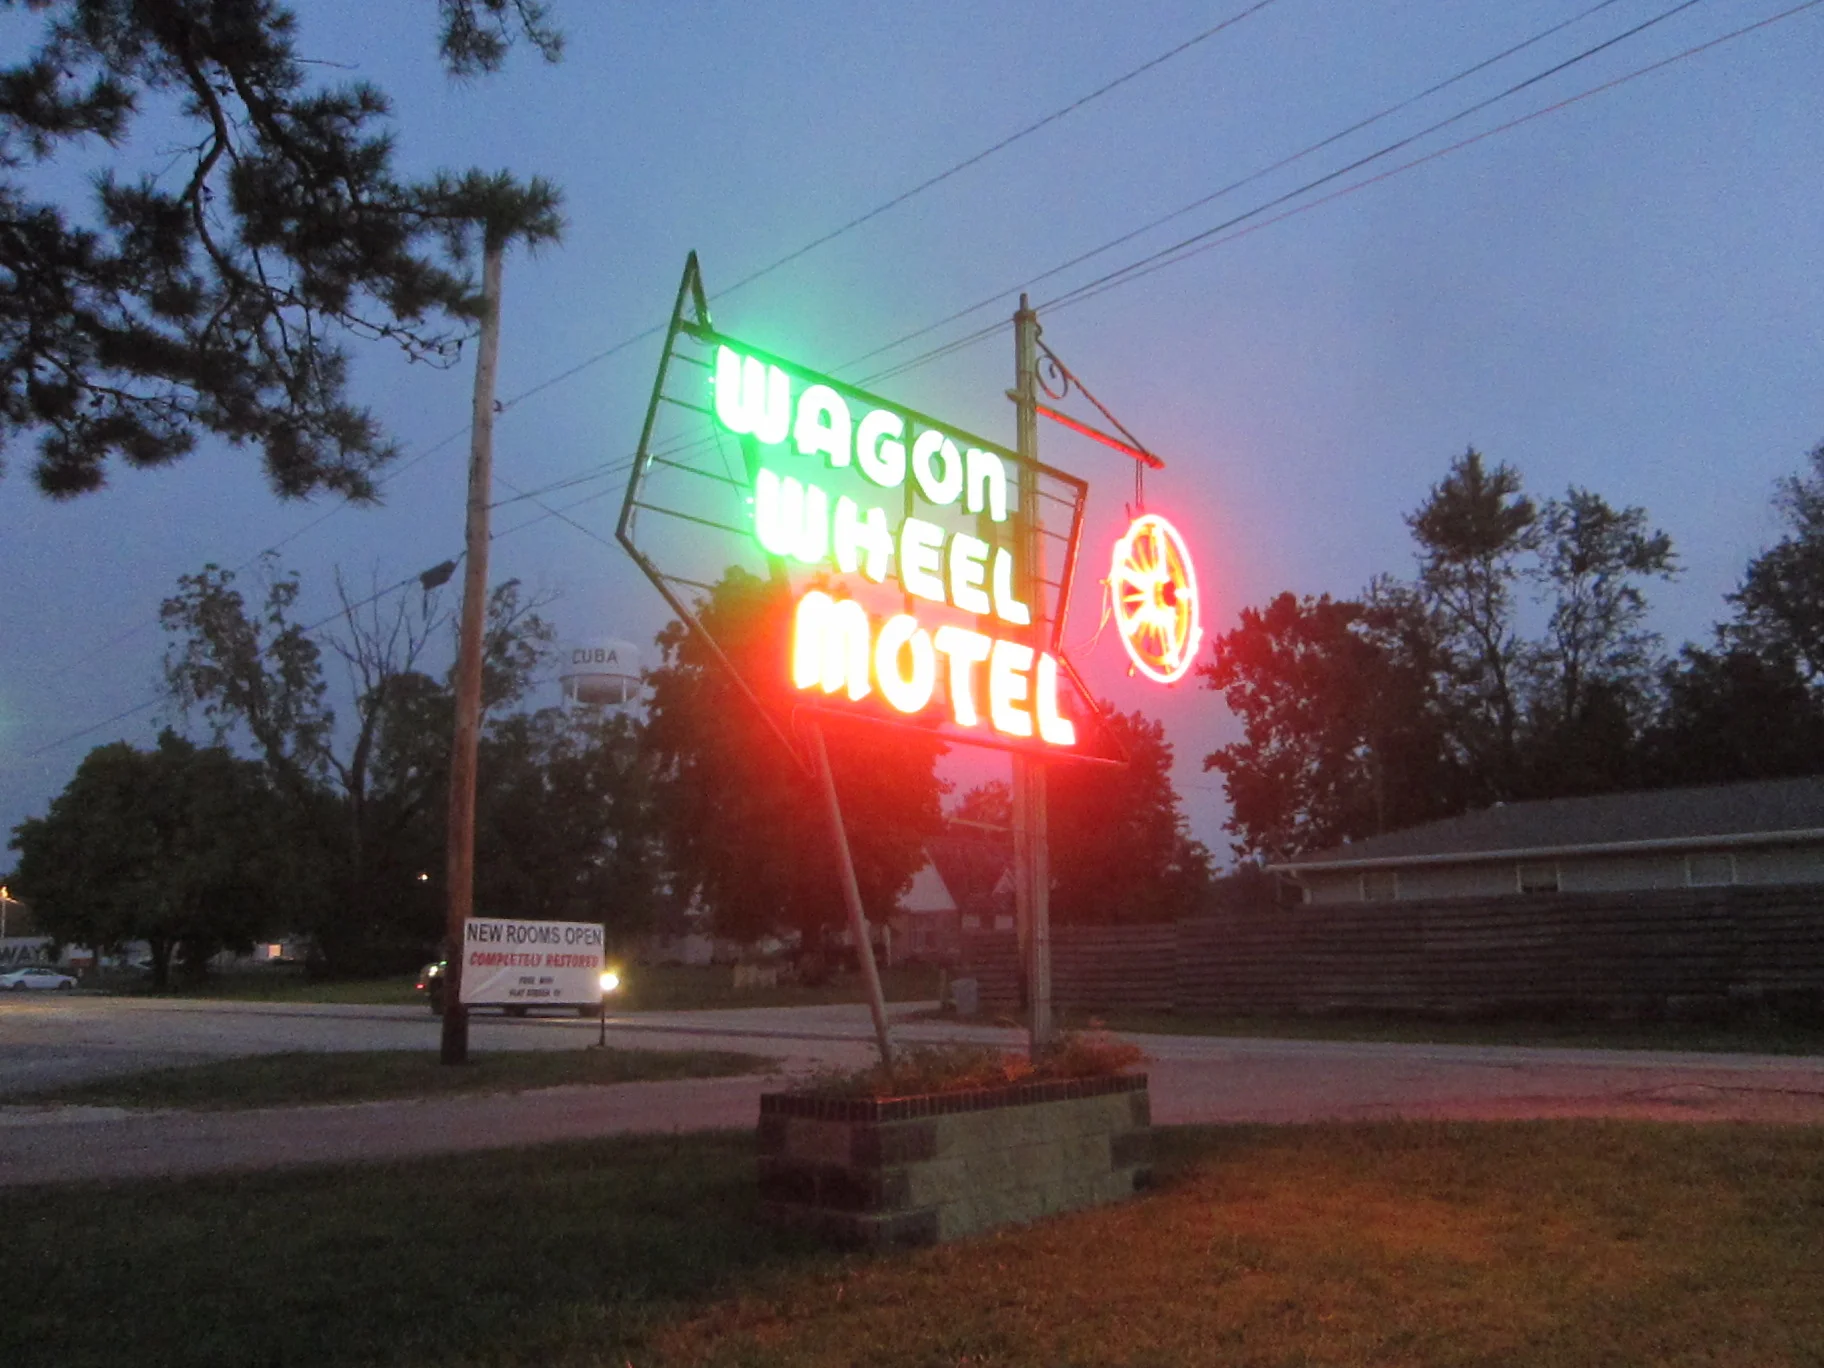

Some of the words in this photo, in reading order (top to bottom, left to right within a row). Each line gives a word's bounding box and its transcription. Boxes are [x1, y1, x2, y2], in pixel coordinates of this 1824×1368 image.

[715, 344, 1008, 522] WAGON
[755, 467, 1031, 626] WHEEL
[571, 648, 619, 665] CUBA
[793, 590, 1077, 746] MOTEL
[467, 923, 503, 943] NEW
[506, 925, 561, 945] ROOMS
[565, 927, 603, 946] OPEN
[470, 951, 543, 968] COMPLETELY
[545, 953, 600, 969] RESTORED
